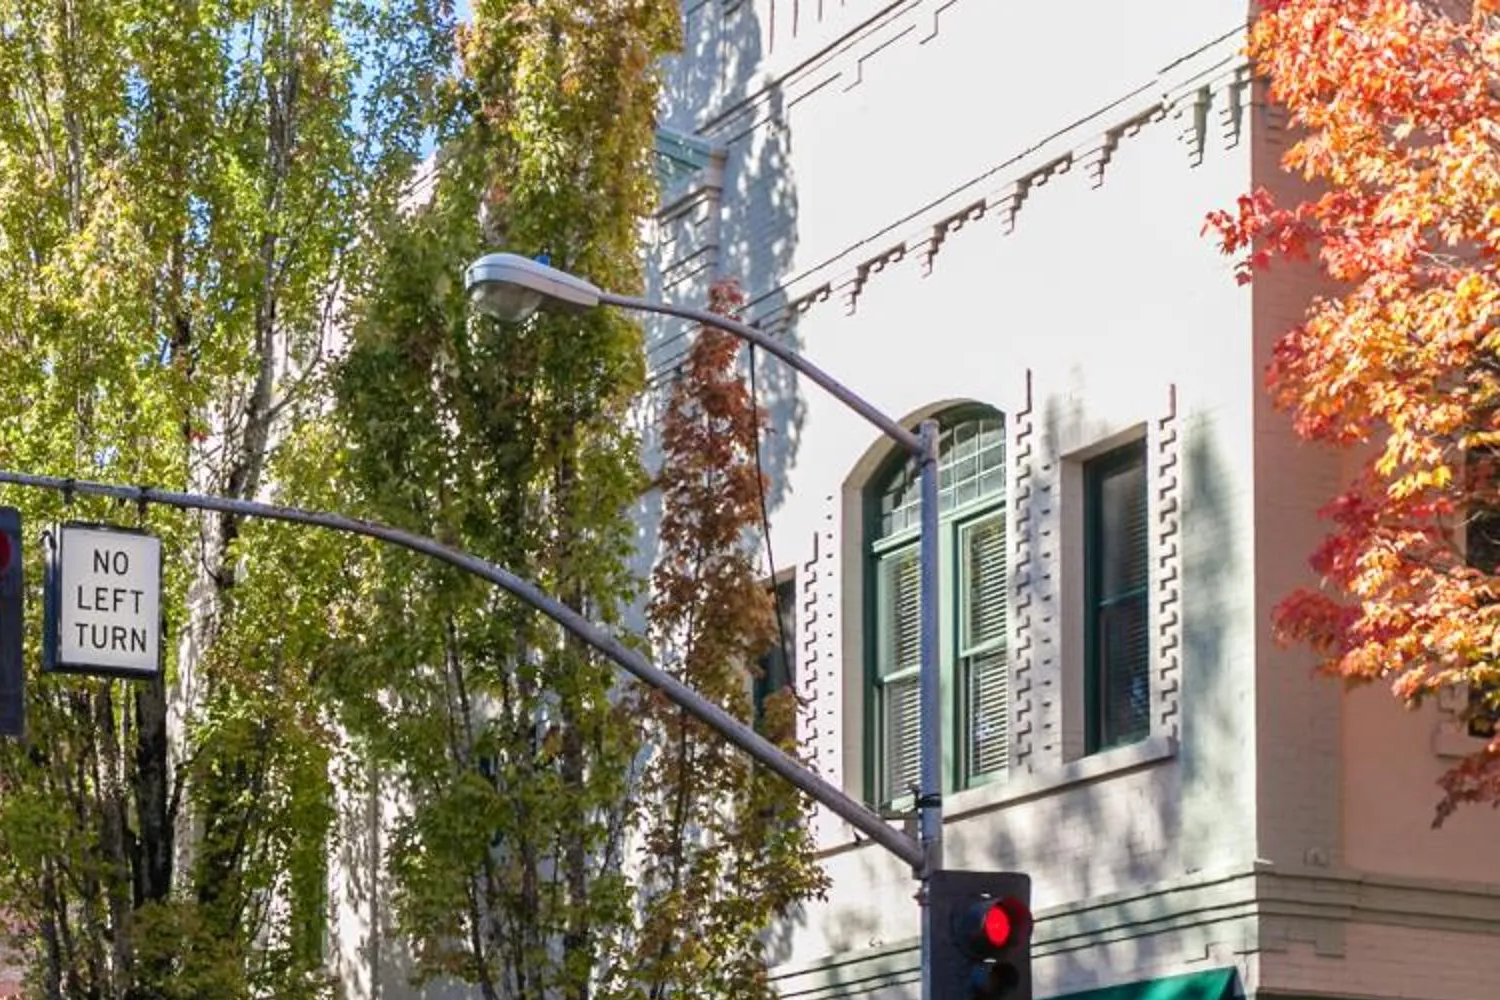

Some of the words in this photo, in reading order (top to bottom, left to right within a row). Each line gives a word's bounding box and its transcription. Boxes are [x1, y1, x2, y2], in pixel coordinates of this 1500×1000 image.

[92, 549, 129, 576] NO
[77, 585, 145, 615] LEFT
[75, 623, 147, 653] TURN
